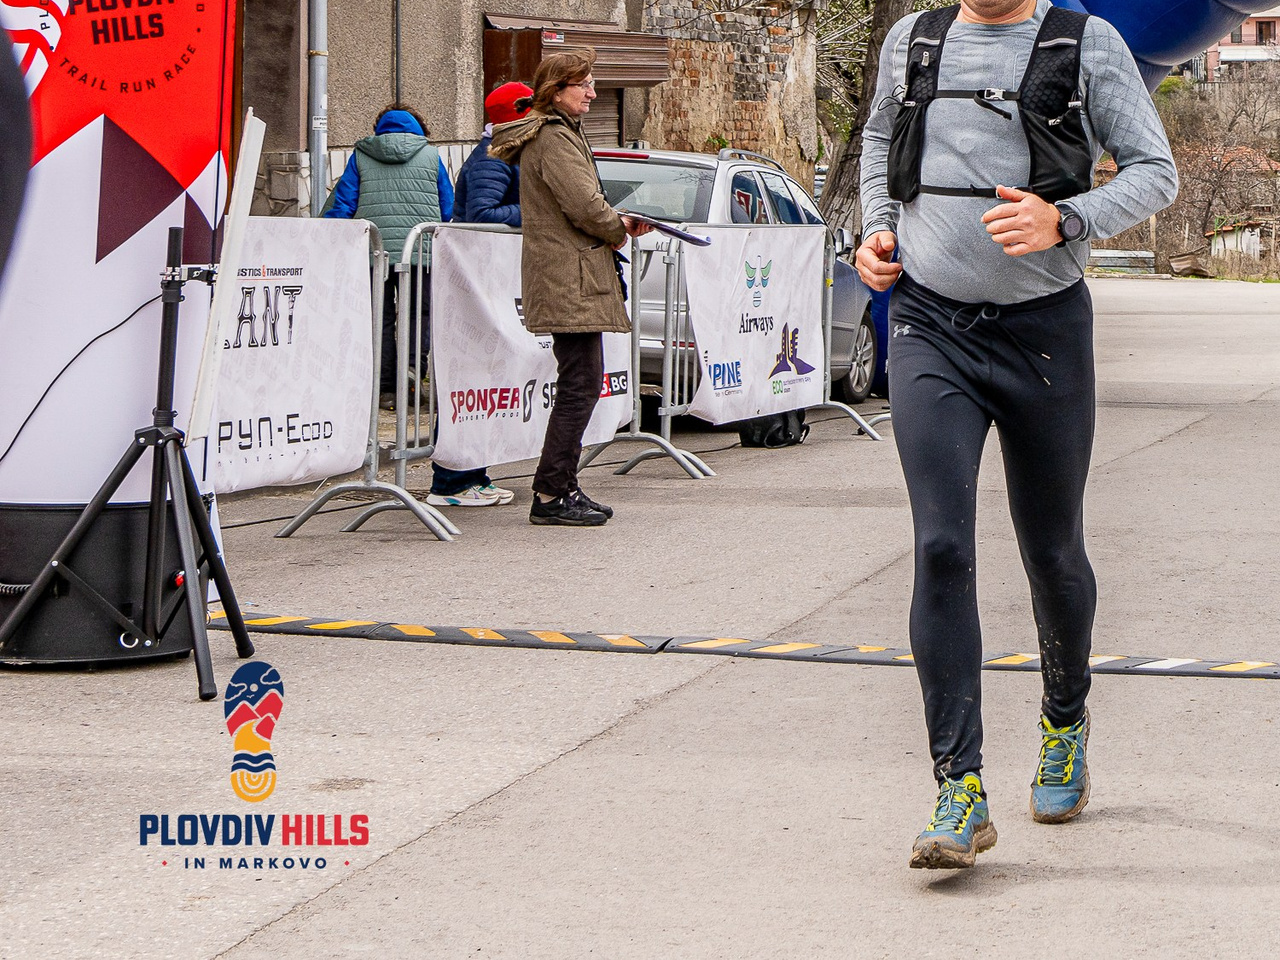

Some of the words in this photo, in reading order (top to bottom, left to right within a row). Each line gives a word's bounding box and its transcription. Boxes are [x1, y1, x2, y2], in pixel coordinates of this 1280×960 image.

[91, 13, 164, 45] HILLS
[59, 58, 107, 91] TRAIL
[119, 80, 156, 93] RUN
[163, 44, 196, 81] RACE
[266, 268, 303, 276] TRANSPORT
[224, 285, 303, 349] ANT
[739, 312, 774, 336] Airways
